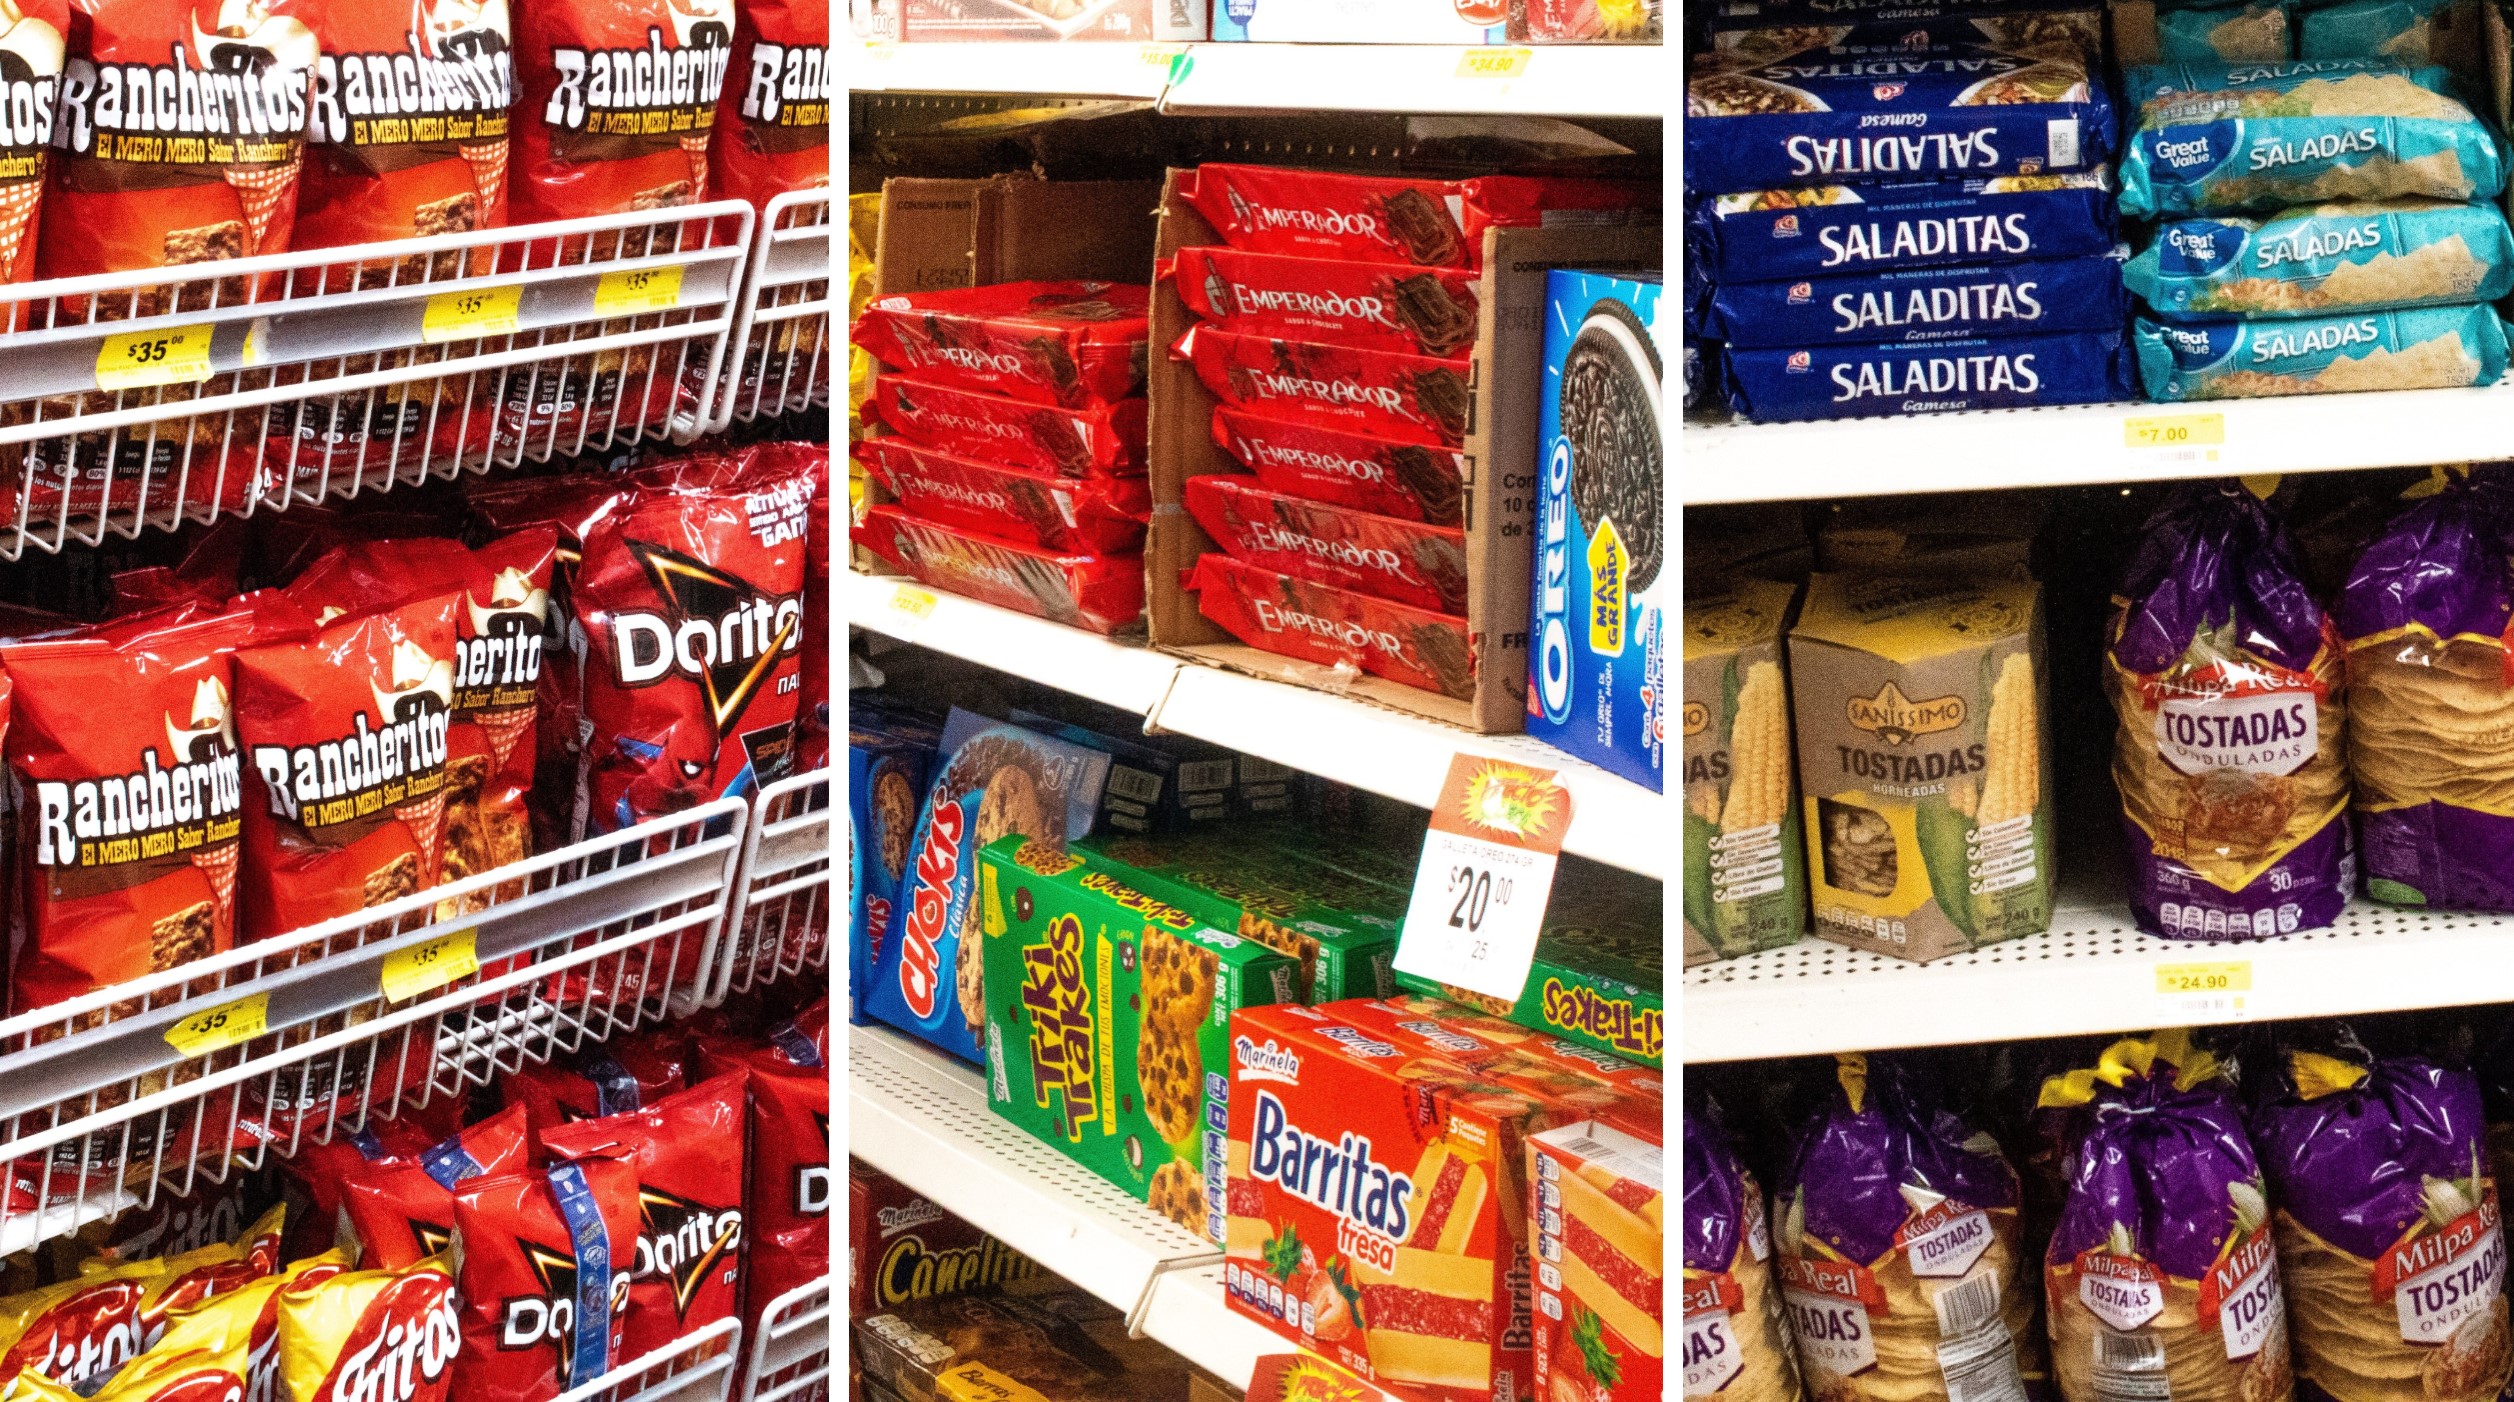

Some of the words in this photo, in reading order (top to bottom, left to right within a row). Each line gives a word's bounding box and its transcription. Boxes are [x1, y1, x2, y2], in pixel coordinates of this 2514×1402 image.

[1764, 58, 2019, 80] SALADITAS
[53, 46, 308, 153] Rancheritos
[781, 104, 793, 126] El
[793, 103, 823, 125] MERO
[1861, 112, 1927, 128] Gamesa
[353, 120, 368, 145] El
[371, 118, 409, 144] MERO
[411, 116, 444, 142] MERO
[447, 116, 473, 139] Sabor
[586, 112, 601, 133] El
[603, 110, 640, 134] MERO
[641, 110, 671, 133] MERO
[670, 108, 695, 132] Sabor
[97, 133, 112, 159] El
[116, 135, 163, 162] MERO
[165, 138, 205, 164] MERO
[208, 138, 235, 163] Sabor
[236, 139, 288, 162] Ranchero
[1785, 127, 2000, 176] SALADITAS
[2156, 136, 2208, 159] Great
[2170, 151, 2210, 169] Value
[2249, 127, 2378, 171] SALADAS
[1818, 213, 2030, 266] SALADITAS
[2169, 229, 2215, 251] Great
[2179, 246, 2217, 262] Value
[2257, 223, 2382, 270] SALADAS
[1233, 283, 1394, 328] EMPERADOR
[1833, 282, 2043, 333] SALADITAS
[2252, 318, 2378, 364] SALADAS
[1248, 368, 1411, 418] EMPERADOR
[1831, 354, 2041, 402] SALADITAS
[1902, 397, 1968, 413] Gamesa
[2138, 427, 2189, 443] $7.00
[1254, 438, 1393, 487] EMPERADOR
[1504, 497, 1520, 513] 10
[1502, 522, 1521, 536] de
[1252, 522, 1411, 579] EMPERADOR
[1541, 443, 1571, 711] OREO
[1593, 563, 1608, 629] MÁS
[1605, 537, 1619, 647] GRANDE
[614, 597, 804, 682] Dorito
[1255, 599, 1411, 663] EMPERADOR
[1642, 608, 1657, 682] paquetes
[1604, 662, 1613, 698] AHORA
[1641, 688, 1654, 710] 4
[2164, 704, 2307, 748] TOSTADAS
[1837, 742, 1987, 783] TOSTADAS
[2176, 744, 2302, 767] ONDULADAS
[303, 805, 316, 827] El
[319, 800, 354, 826] MERO
[356, 792, 382, 819] MERO
[1873, 782, 1946, 798] HORNEADAS
[82, 843, 95, 866] El
[99, 840, 139, 864] MERO
[141, 834, 175, 859] MERO
[178, 827, 204, 850] Sabor
[2270, 872, 2292, 893] 30
[900, 800, 965, 1018] CHOKIS
[948, 874, 968, 940] Clásica
[1099, 944, 1112, 1011] EMOCIONES
[1216, 975, 1228, 1002] 306
[1315, 958, 1328, 986] 306
[1021, 943, 1062, 1107] Triki
[1046, 911, 1098, 1143] Trakes
[1100, 1013, 1112, 1036] TUS
[1100, 1039, 1112, 1057] DE
[1237, 1034, 1300, 1074] Marinela
[1101, 1060, 1114, 1101] CHISPA
[1102, 1106, 1115, 1127] LA
[1449, 1115, 1459, 1135] 5
[1252, 1092, 1412, 1242] Barritas
[1339, 1217, 1396, 1275] fresa
[1917, 1215, 1985, 1262] TOSTADAS
[2395, 1224, 2473, 1281] Milpa
[1803, 1261, 1858, 1297] Real
